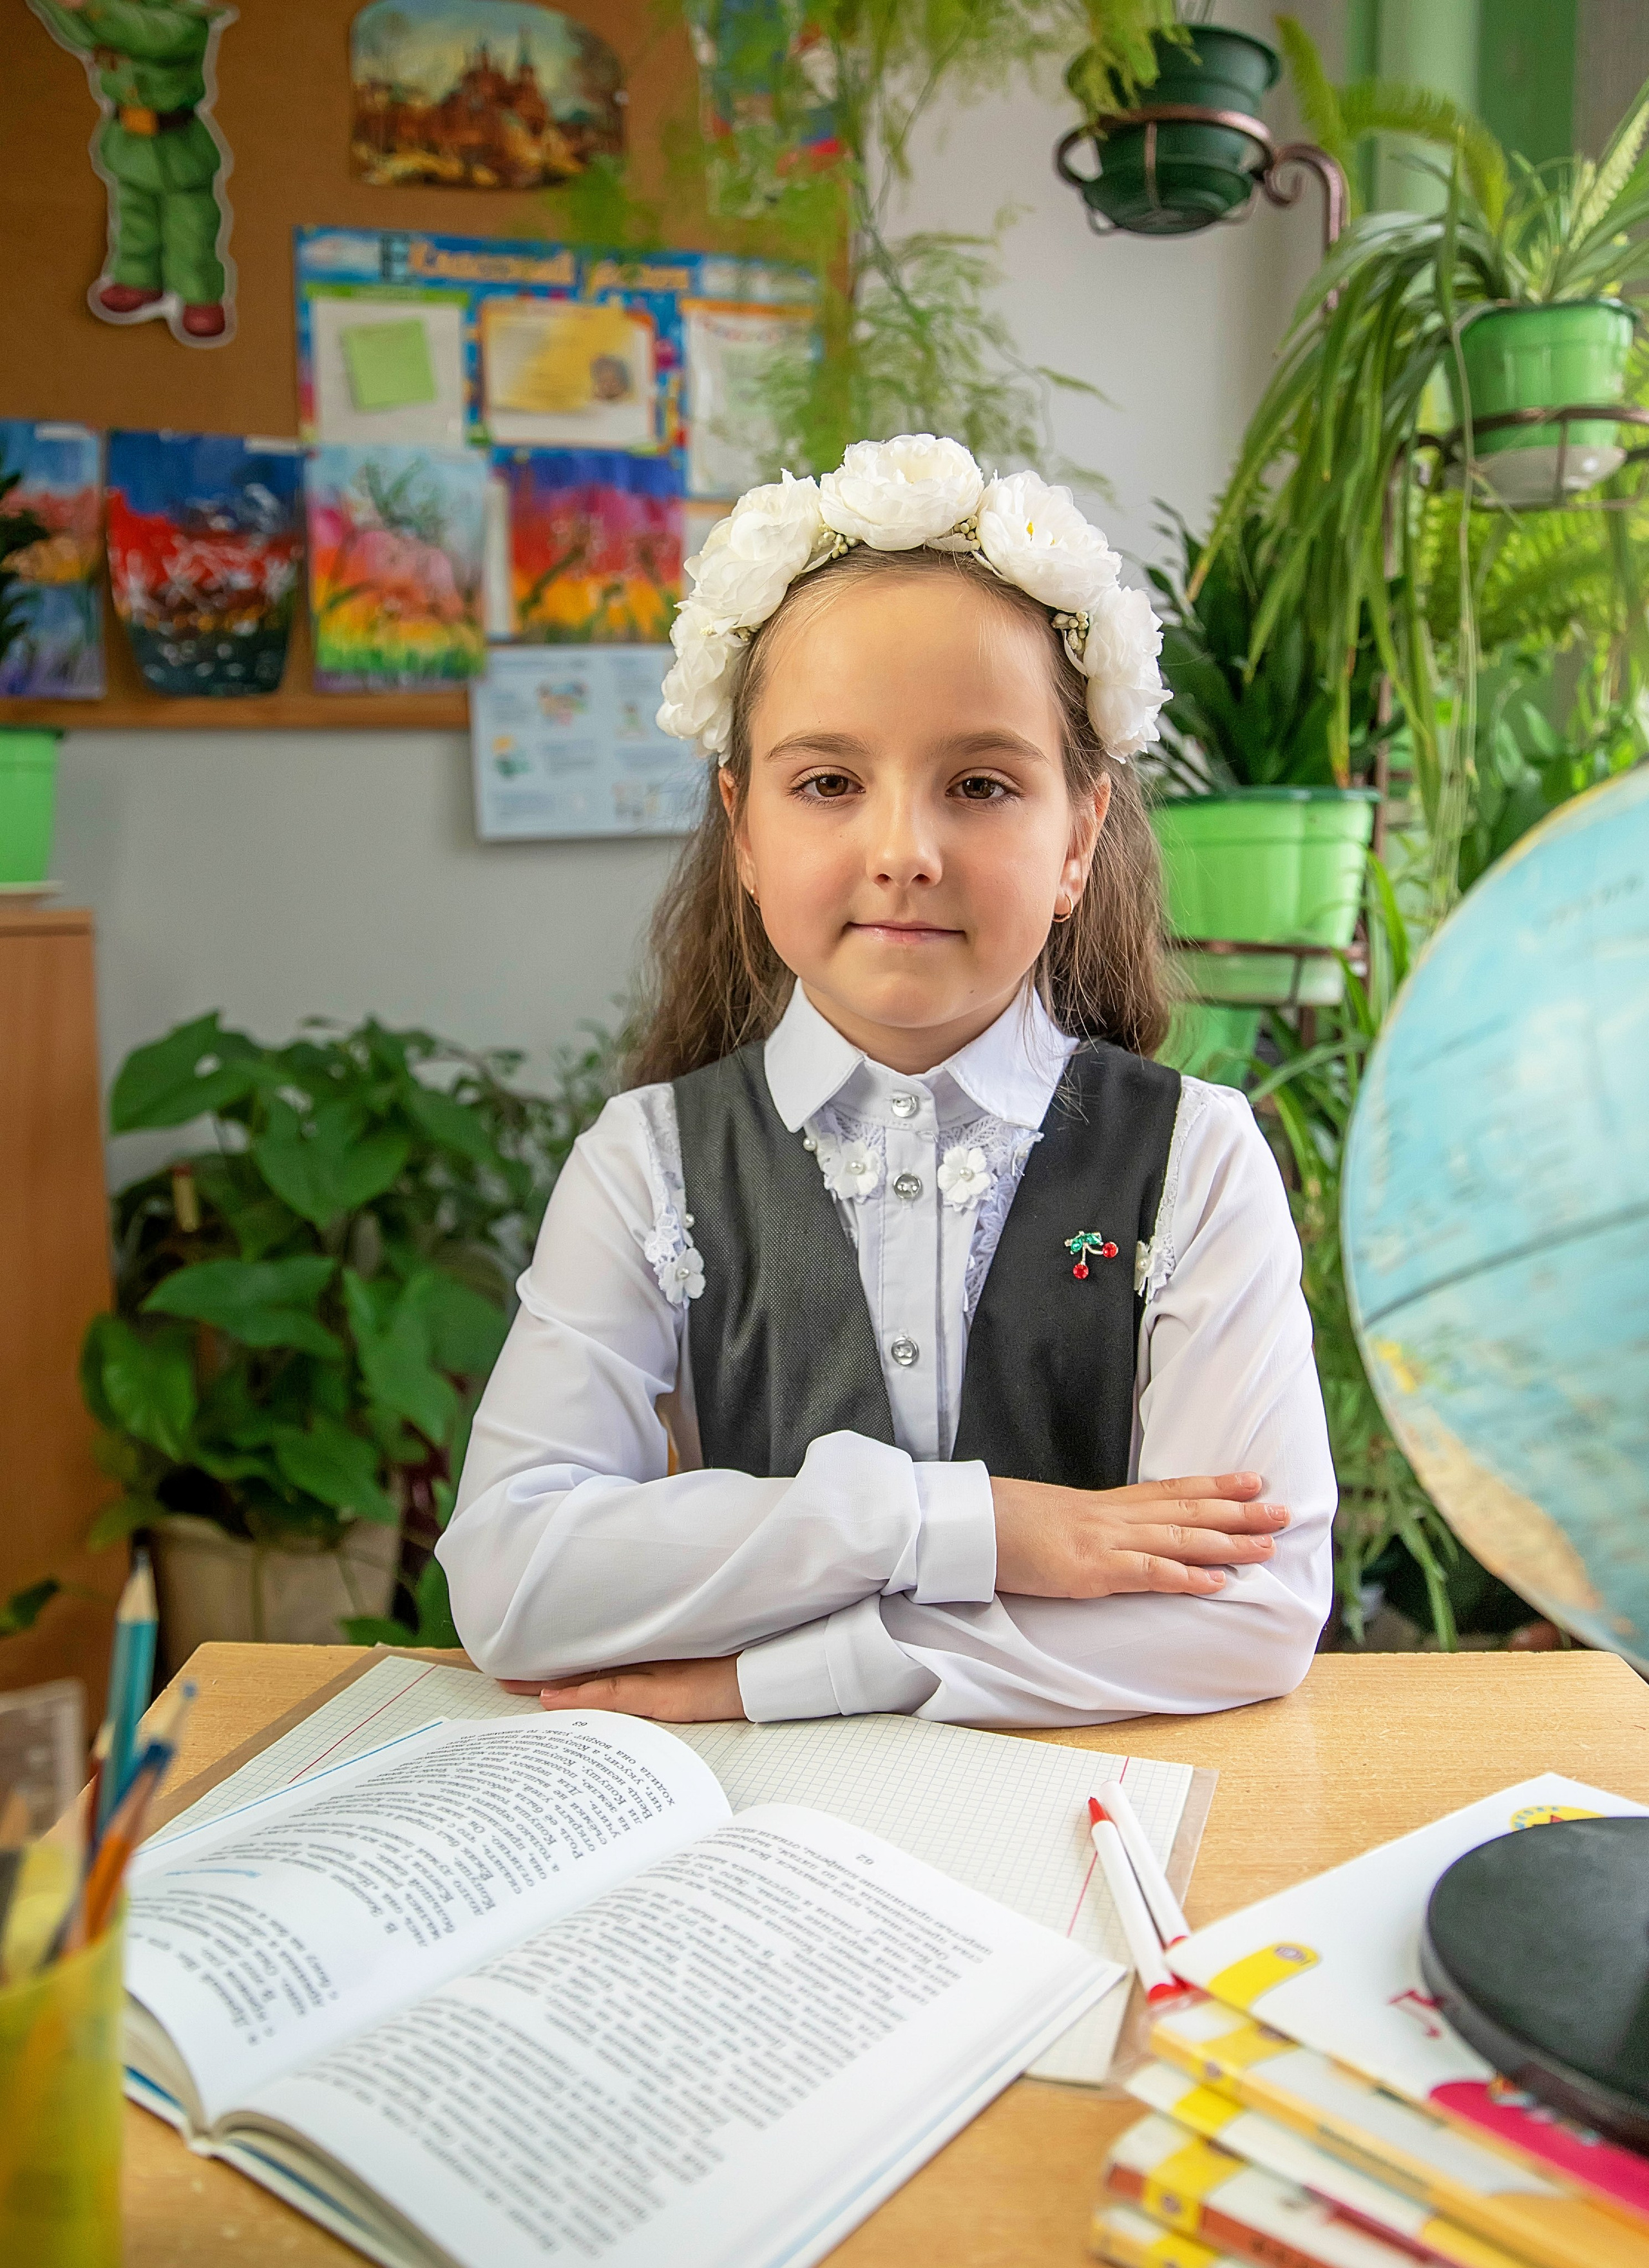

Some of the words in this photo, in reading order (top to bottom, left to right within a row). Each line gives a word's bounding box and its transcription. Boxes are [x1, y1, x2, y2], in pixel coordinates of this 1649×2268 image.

[548, 1737, 591, 1751] Копуша
[573, 1734, 613, 1750] вокруг
[520, 1755, 578, 1778] положили
[532, 1749, 577, 1766] Копуша
[562, 1747, 625, 1785] незнакомая,
[616, 1750, 636, 1764] она
[478, 1770, 520, 1784] достать
[509, 1761, 552, 1777] первого
[511, 1770, 551, 1788] вышло
[604, 1753, 643, 1784] укусит,
[522, 1783, 553, 1803] улей,
[552, 1790, 568, 1800] не
[557, 1778, 583, 1795] Для
[582, 1766, 626, 1805] Копушу.
[582, 1779, 617, 1813] землю,
[640, 1766, 674, 1805] ходила
[481, 1790, 510, 1804] тоже
[514, 1792, 543, 1813] была
[627, 1787, 653, 1819] Вещь
[645, 1786, 662, 1812] чит,
[472, 1797, 515, 1822] сердито
[542, 1814, 558, 1826] её
[589, 1800, 621, 1838] учить.
[627, 1808, 642, 1824] ли
[464, 1805, 526, 1850] приглашая
[468, 1820, 485, 1833] Он
[513, 1804, 557, 1845] Копуша
[554, 1804, 595, 1851] открыть
[569, 1802, 607, 1844] съёмки
[617, 1815, 631, 1831] на
[435, 1829, 460, 1847] был
[456, 1828, 476, 1843] что
[515, 1823, 551, 1861] только
[560, 1828, 584, 1859] Роль
[461, 1847, 493, 1881] Ёжик
[491, 1835, 534, 1887] отлично.
[747, 1847, 772, 1860] Вся
[855, 1854, 874, 1865] 62
[482, 1844, 521, 1894] сказать,
[528, 1853, 546, 1880] она,
[551, 1863, 560, 1872] а
[454, 1857, 495, 1910] Копуше.
[381, 1893, 403, 1914] она
[408, 1878, 455, 1933] большой
[453, 1880, 484, 1915] долго
[384, 1922, 398, 1934] В
